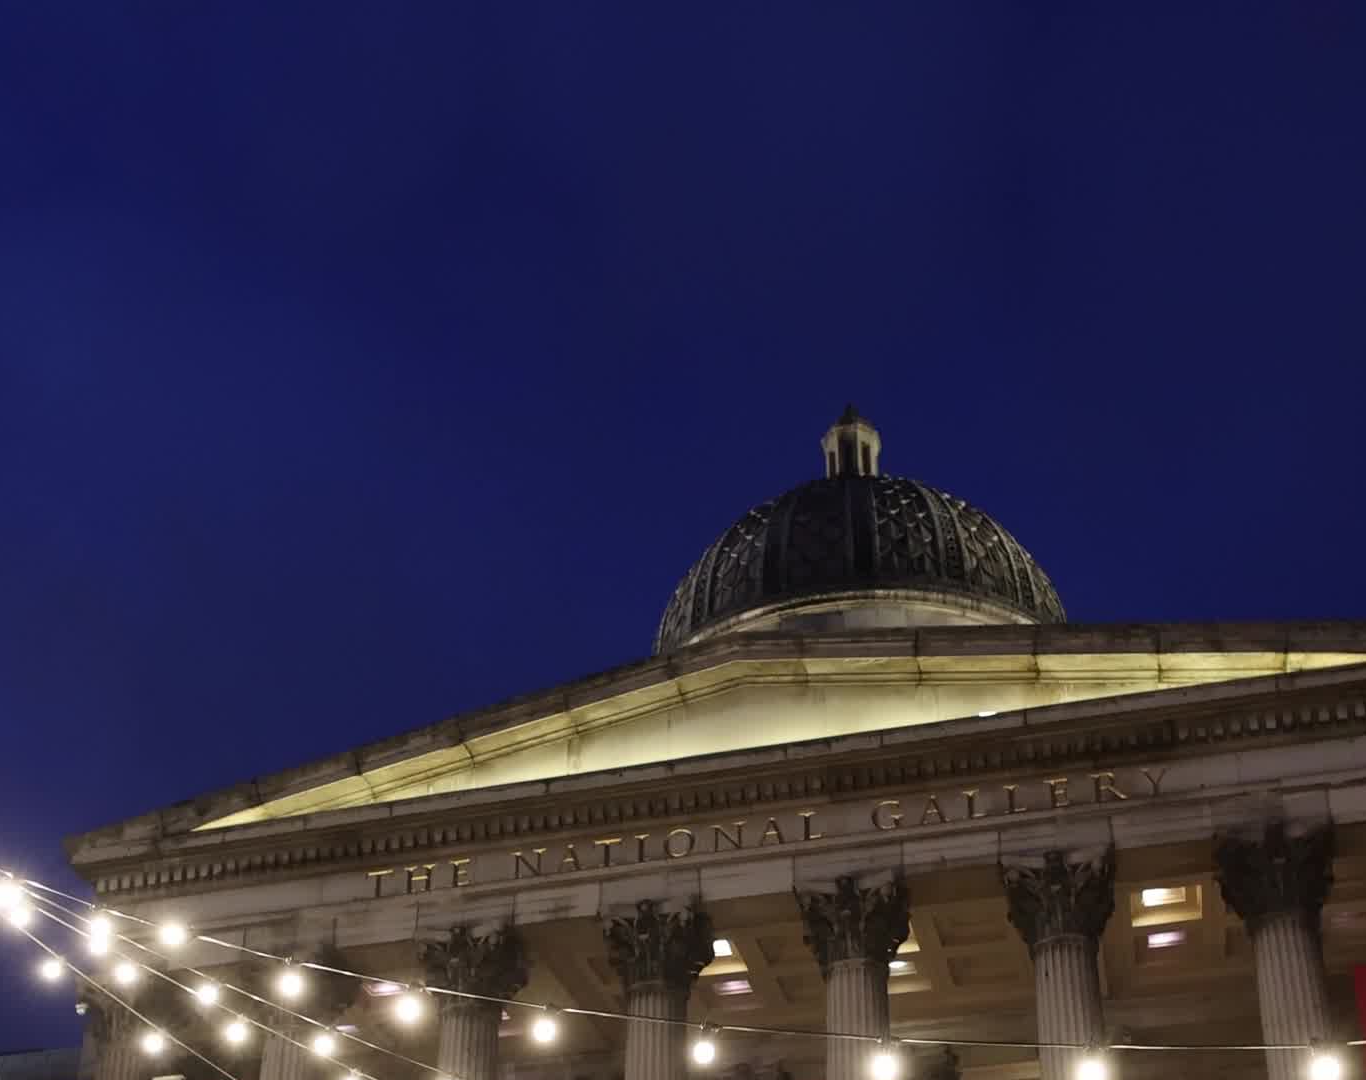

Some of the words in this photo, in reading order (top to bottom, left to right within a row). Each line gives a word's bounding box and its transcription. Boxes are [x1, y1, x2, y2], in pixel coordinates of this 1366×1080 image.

[366, 858, 472, 897] THE
[510, 811, 826, 880] NATIONAL
[871, 766, 1169, 832] GALLERY
